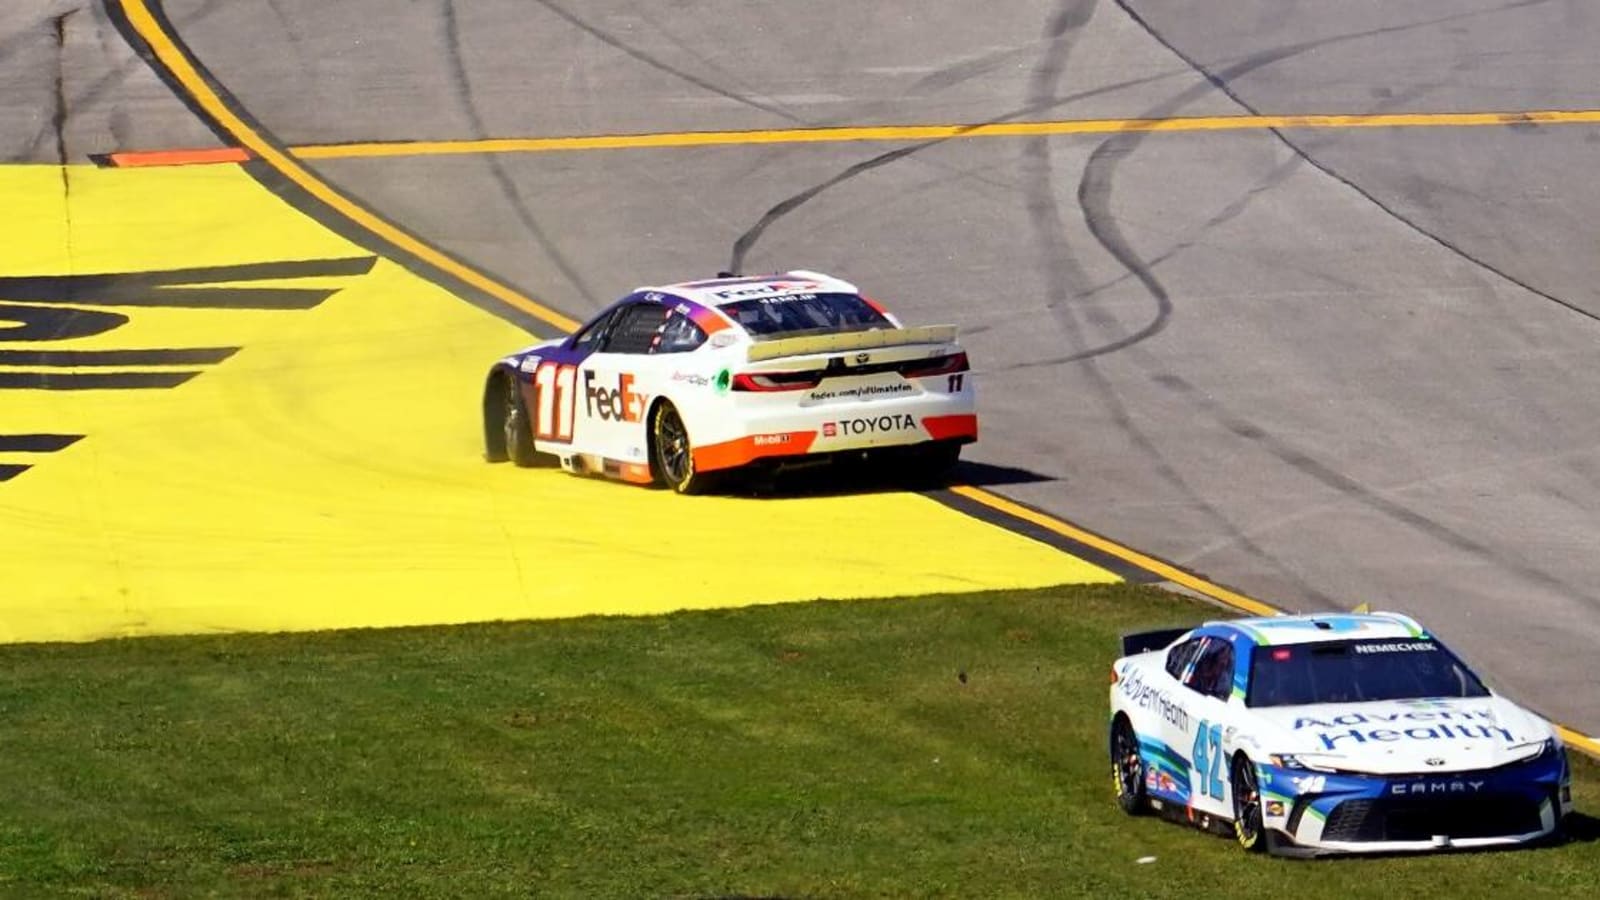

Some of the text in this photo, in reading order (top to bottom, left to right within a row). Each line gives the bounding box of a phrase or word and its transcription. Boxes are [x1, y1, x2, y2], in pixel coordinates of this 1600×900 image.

[584, 369, 649, 423] FedEx
[947, 374, 964, 393] 11
[535, 361, 577, 444] 11
[840, 414, 917, 436] TOYOTA
[1354, 642, 1439, 654] NEMECHEK
[1318, 724, 1515, 751] Health
[1192, 719, 1225, 802] 42
